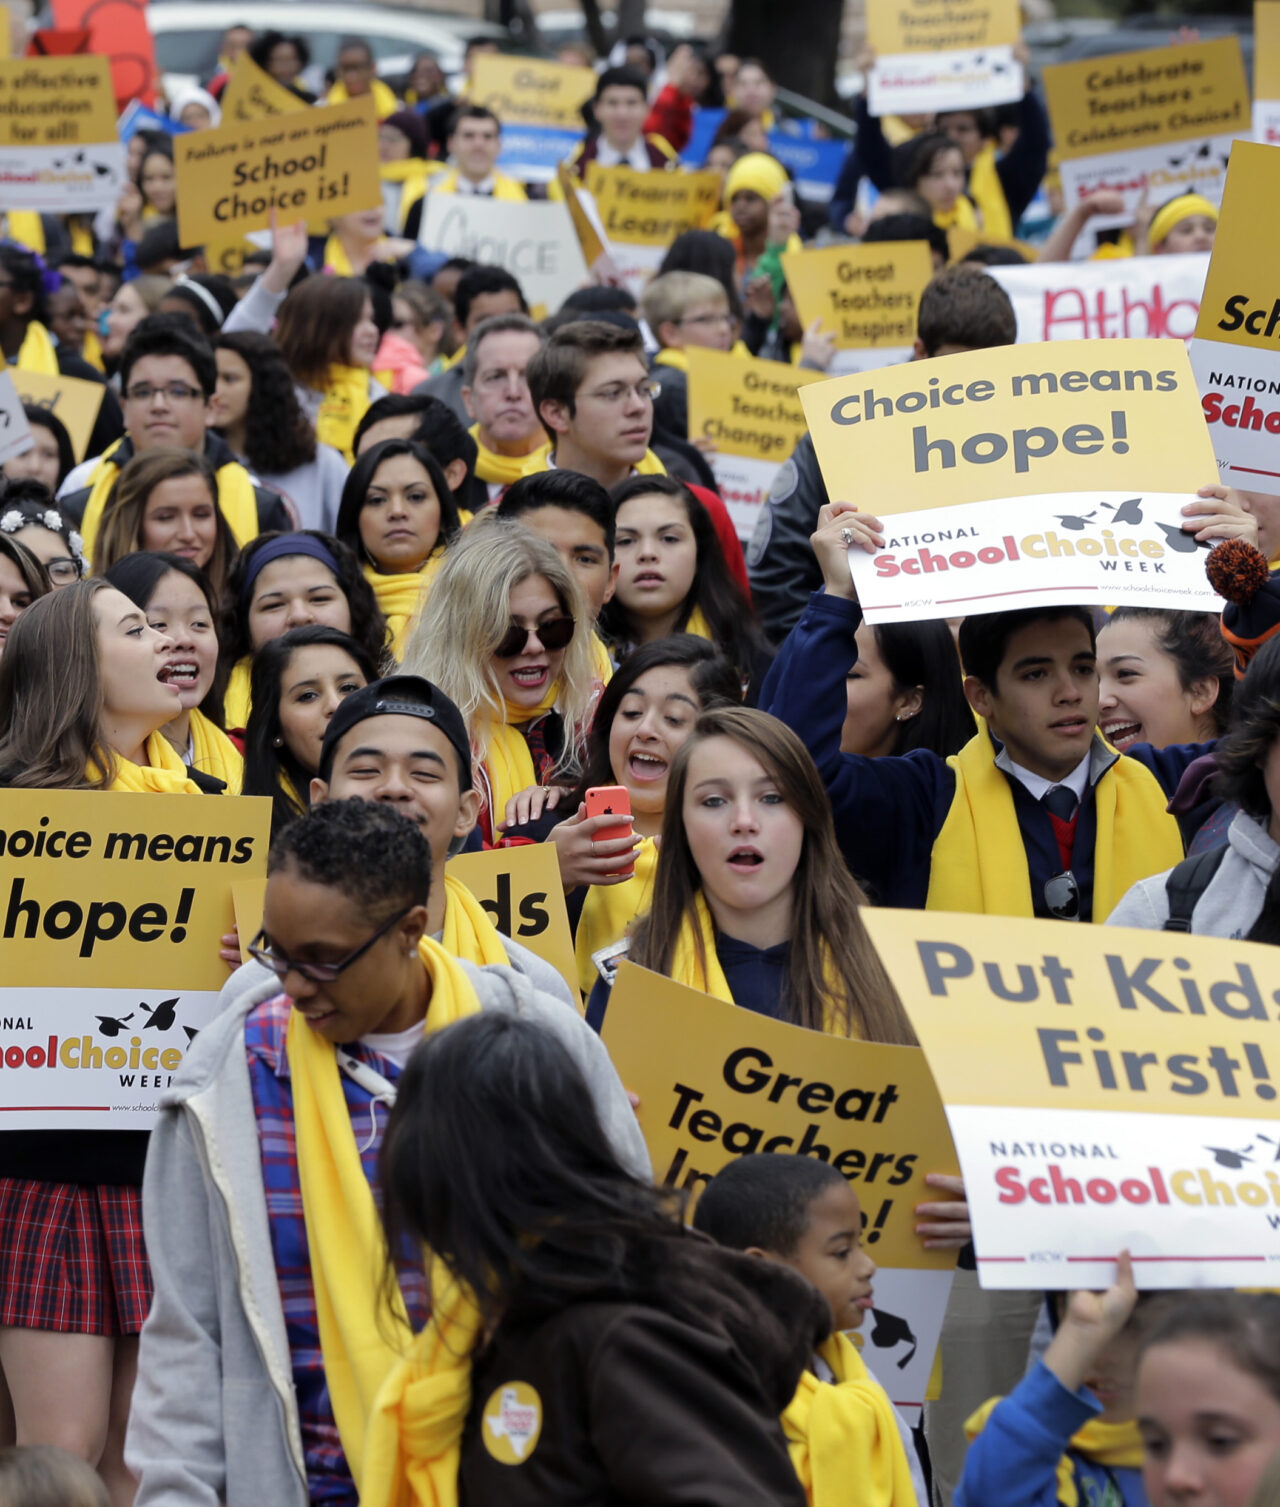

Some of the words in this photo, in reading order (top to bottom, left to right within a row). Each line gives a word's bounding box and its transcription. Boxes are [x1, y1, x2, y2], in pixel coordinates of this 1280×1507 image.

[1085, 59, 1205, 92] Celebrate
[1087, 87, 1193, 117] Teachers
[1066, 119, 1161, 147] Celebrate
[1167, 100, 1242, 131] Choice!
[232, 144, 327, 187] School
[213, 188, 307, 222] Choice
[318, 172, 350, 202] is!
[837, 262, 895, 284] Great
[829, 289, 914, 311] Teachers
[842, 319, 915, 343] Inspire!
[743, 371, 801, 398] Grea
[830, 377, 996, 427] Choice
[1012, 369, 1178, 397] means
[703, 418, 786, 452] Change
[913, 410, 1130, 474] hope!
[881, 526, 981, 549] ATIONAL
[1099, 559, 1167, 574] WEEK
[103, 831, 256, 865] means
[2, 877, 196, 959] hope!
[914, 939, 1075, 1006] Put
[1035, 1025, 1279, 1101] First!
[722, 1046, 900, 1124] Great
[667, 1082, 919, 1187] Teachers
[989, 1140, 1119, 1160] NATIONAL
